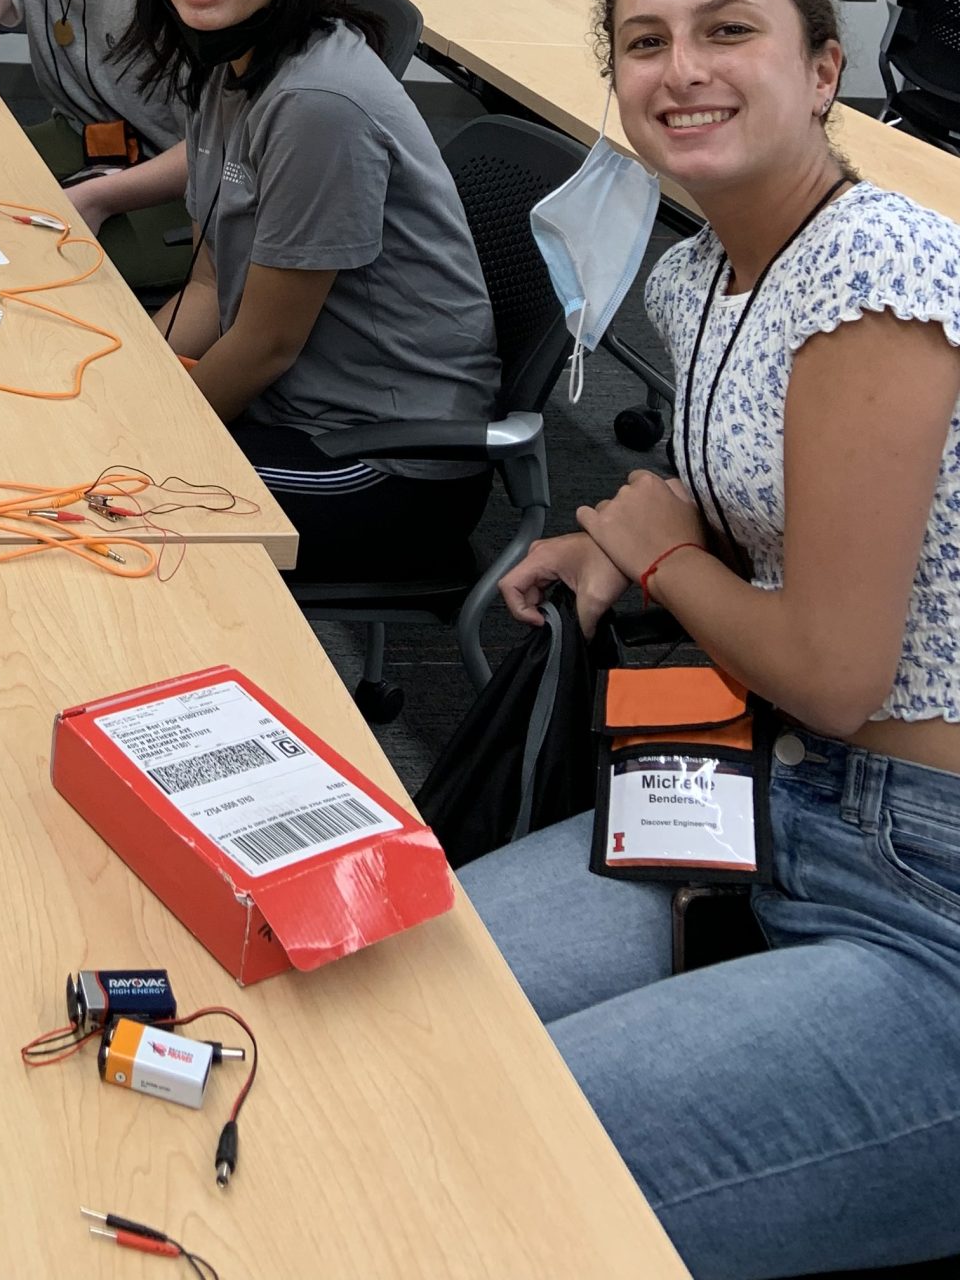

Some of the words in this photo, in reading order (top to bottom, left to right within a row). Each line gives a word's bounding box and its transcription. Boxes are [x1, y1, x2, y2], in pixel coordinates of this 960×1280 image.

[260, 729, 286, 740] FedEx
[278, 740, 300, 755] G
[639, 755, 672, 763] GRAINER
[642, 775, 715, 791] Michelle
[641, 818, 671, 826] Discover
[673, 819, 717, 829] Engineering
[109, 978, 166, 988] RAYOVAC
